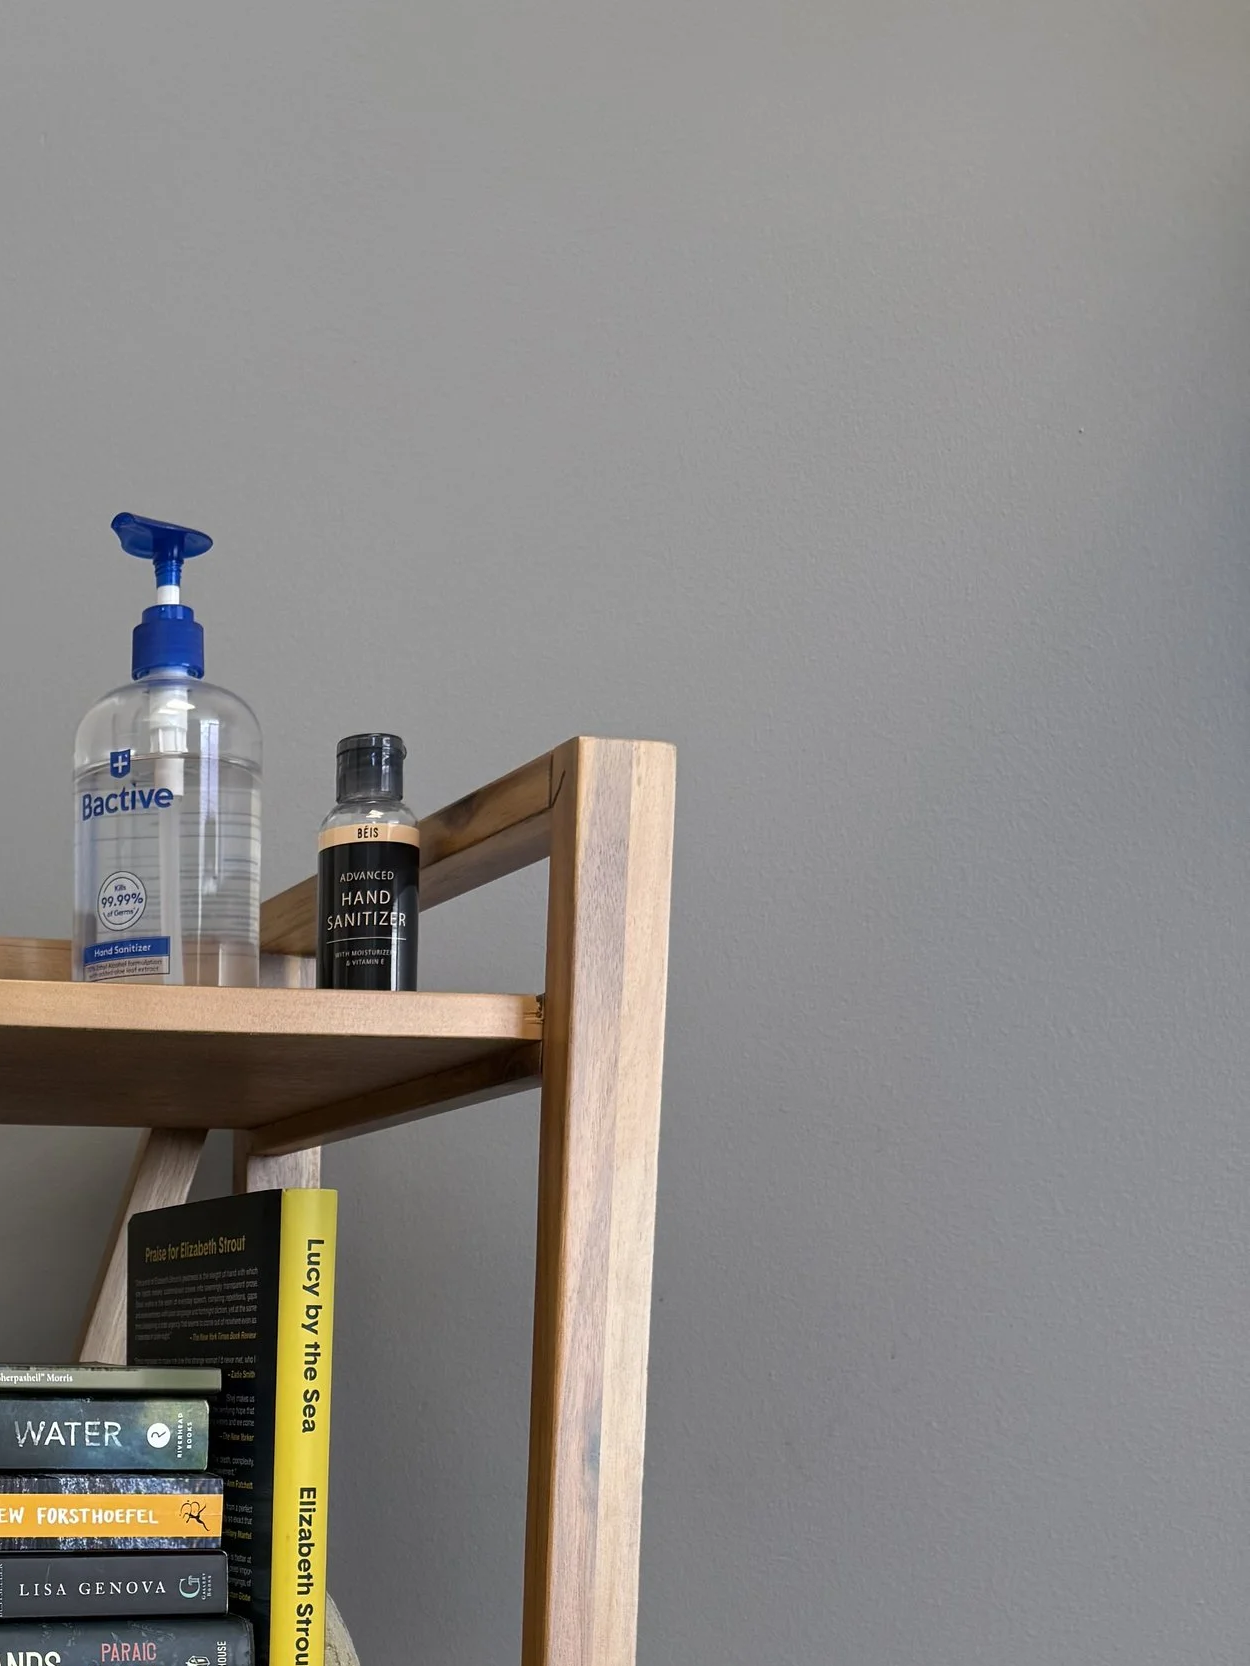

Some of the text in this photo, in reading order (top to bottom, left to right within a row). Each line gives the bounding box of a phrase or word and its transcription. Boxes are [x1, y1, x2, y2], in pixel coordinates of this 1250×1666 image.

[82, 782, 174, 821] Bactive
[357, 826, 379, 839] BÉIS
[340, 871, 394, 882] ADVANCED
[101, 893, 143, 908] 99.99%
[342, 890, 390, 906] HAND
[327, 912, 406, 930] SANITIZER
[94, 944, 151, 957] Hand Sanitizer
[145, 1235, 245, 1263] Praise for Elizabeth Strout
[301, 1239, 324, 1433] Lucy by the Sea
[14, 1421, 122, 1447] WATER
[37, 1507, 158, 1525] FORSTHOEFEL
[297, 1487, 316, 1596] Elizabeth
[19, 1581, 166, 1596] LISA GENOVA
[101, 1643, 157, 1662] PARAIC
